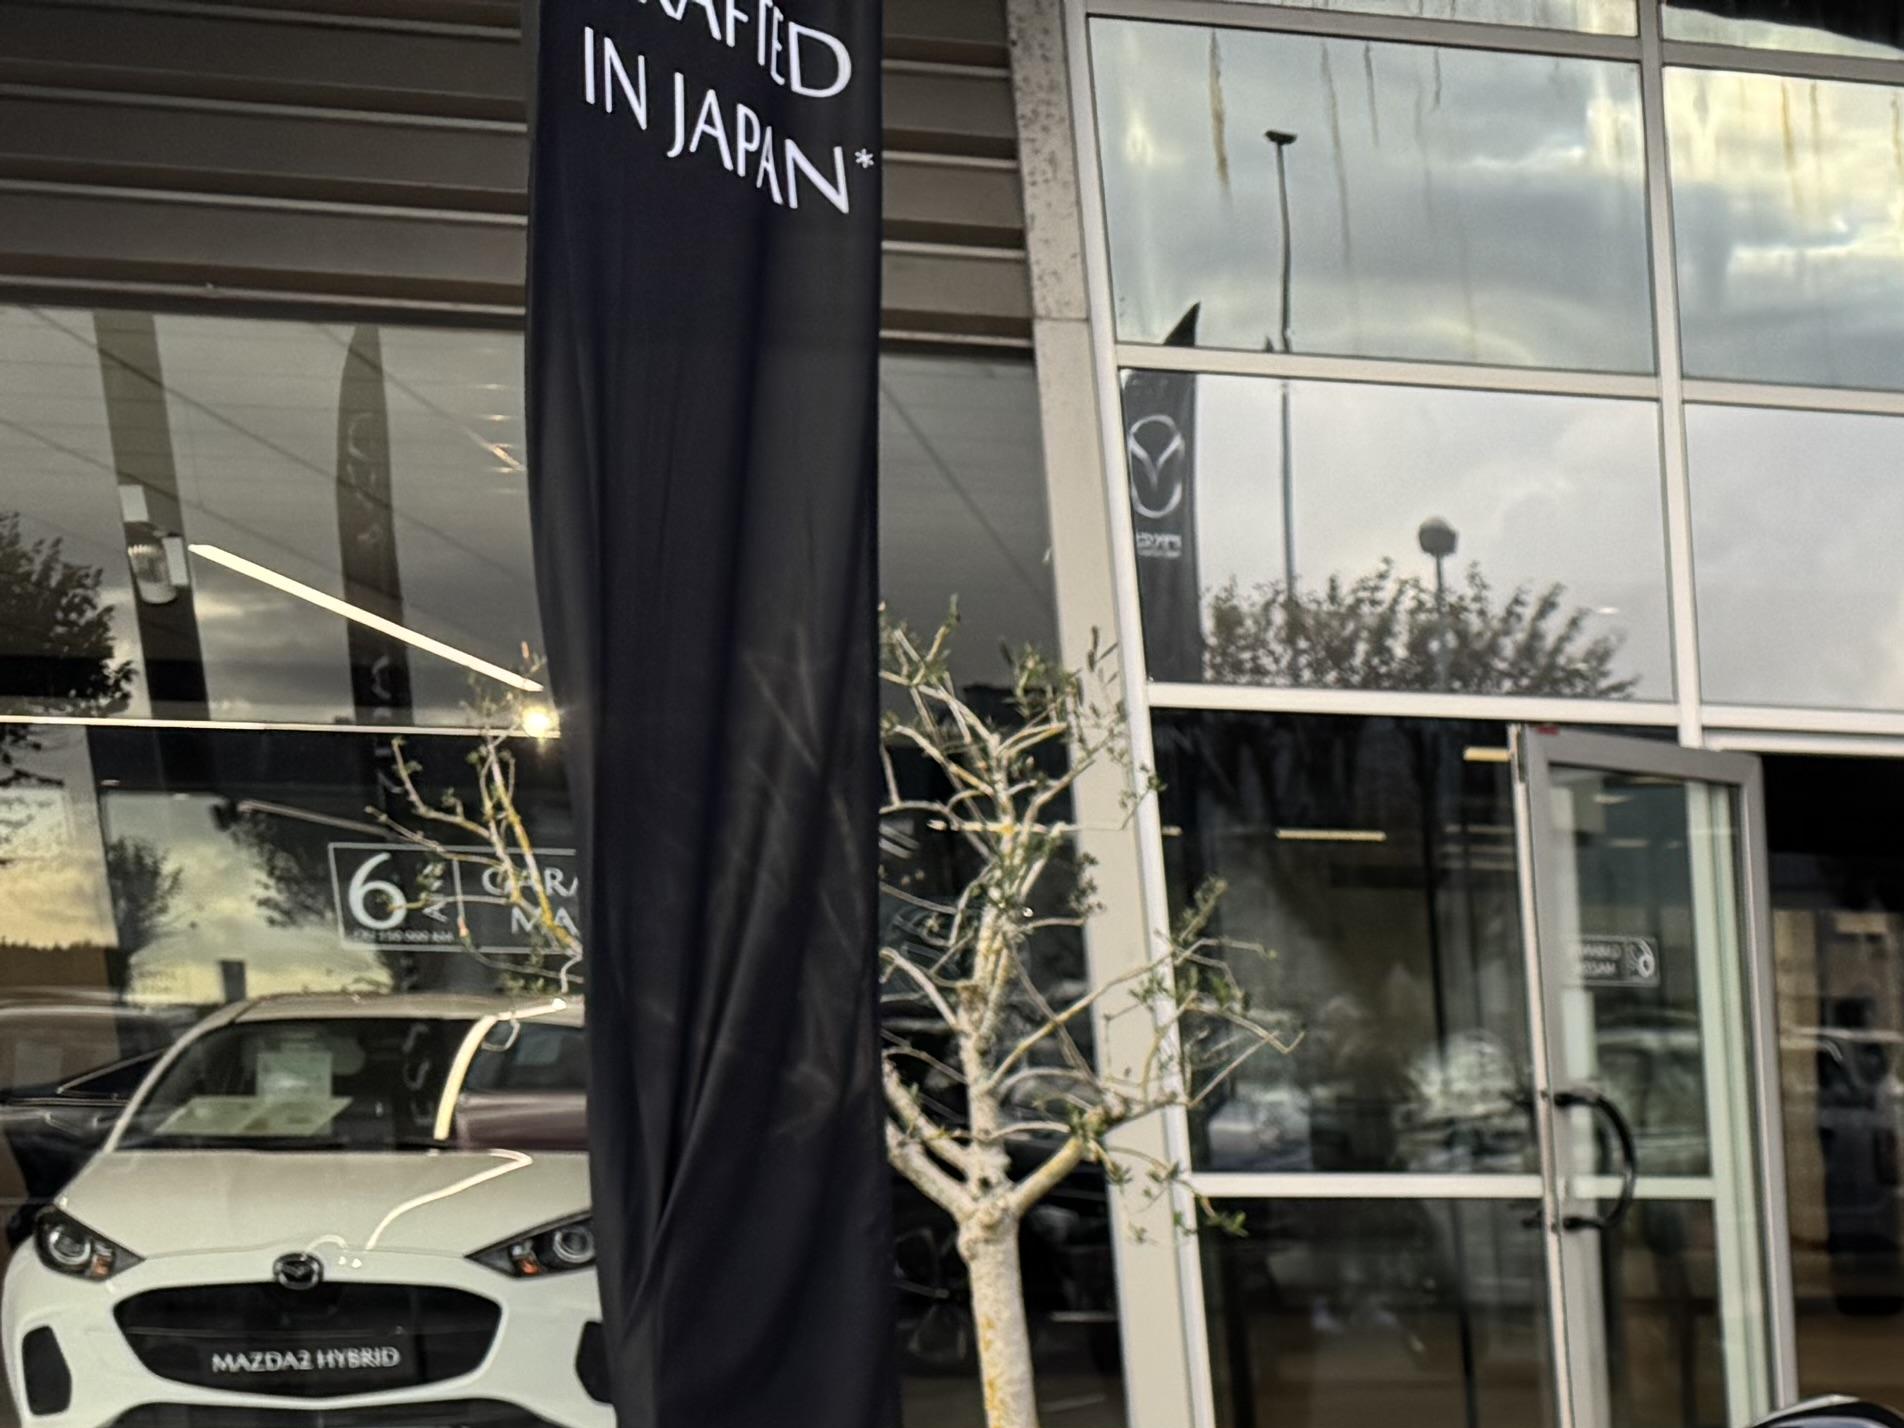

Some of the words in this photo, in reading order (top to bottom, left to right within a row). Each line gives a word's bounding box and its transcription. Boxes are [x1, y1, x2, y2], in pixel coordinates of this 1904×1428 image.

[584, 26, 647, 130] IN
[349, 852, 408, 929] 6
[211, 1349, 314, 1373] MAZDA2
[316, 1346, 400, 1369] HYBRID
